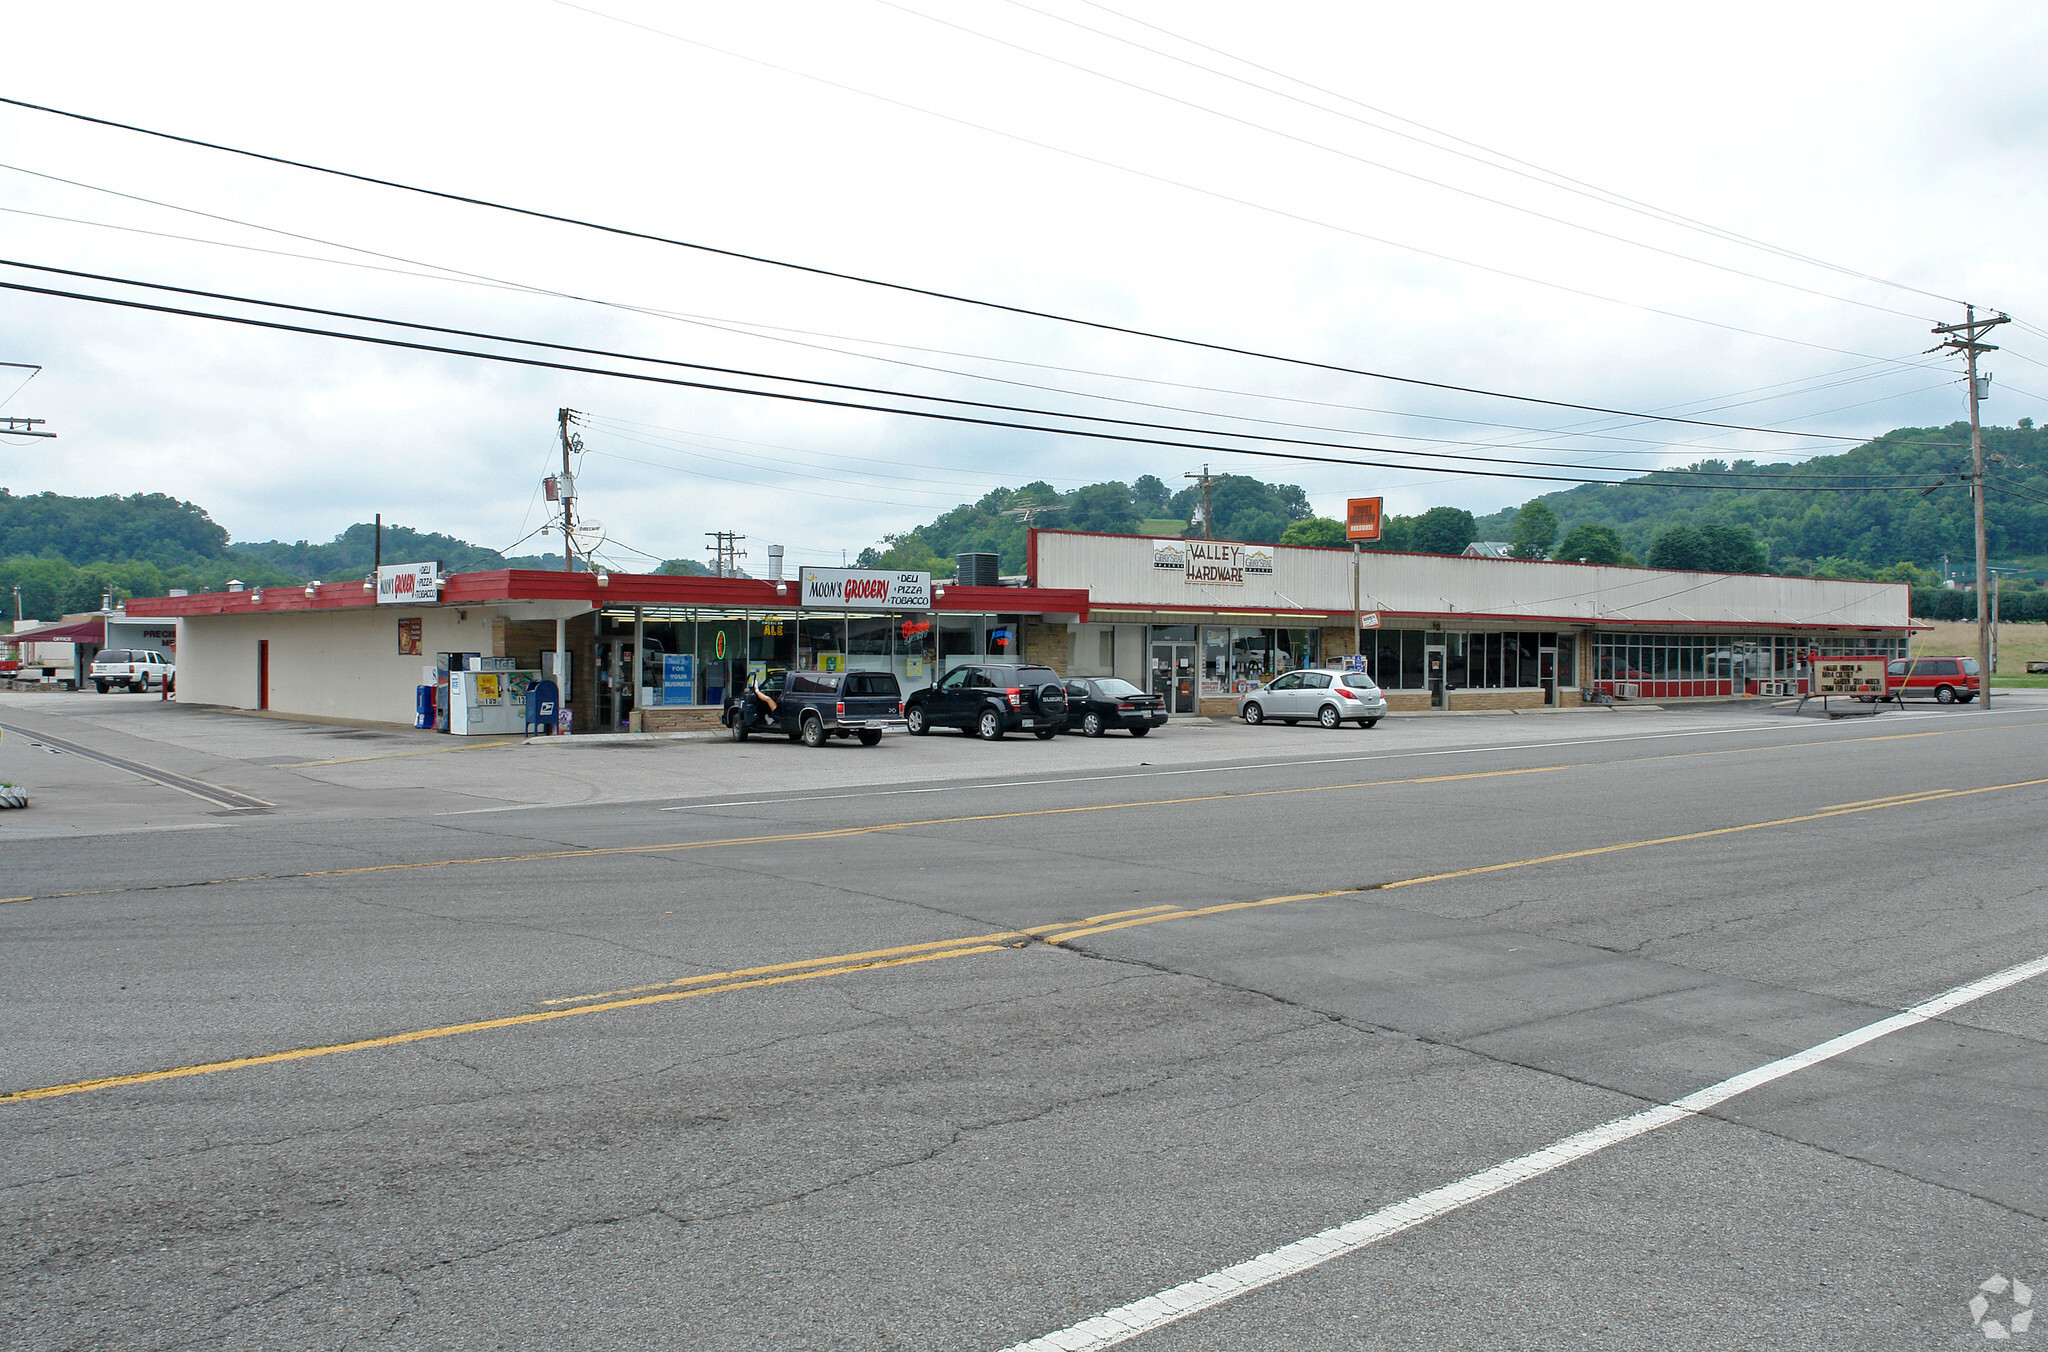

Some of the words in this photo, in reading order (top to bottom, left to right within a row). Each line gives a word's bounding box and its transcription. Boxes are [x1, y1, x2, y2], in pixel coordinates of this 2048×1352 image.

[1190, 544, 1240, 566] VALLEY
[420, 566, 431, 574] DELI
[1186, 560, 1243, 582] HARDWARE
[419, 578, 433, 587] PIZZA
[901, 574, 919, 583] DELI
[395, 573, 416, 599] GROCERY
[897, 586, 923, 594] PIZZA
[416, 589, 436, 599] TOBACCO
[809, 580, 842, 598] MOON'S
[844, 579, 889, 603] GROCERY
[890, 596, 929, 605] TOBACCO
[763, 625, 784, 636] ALE
[496, 660, 516, 669] ICE
